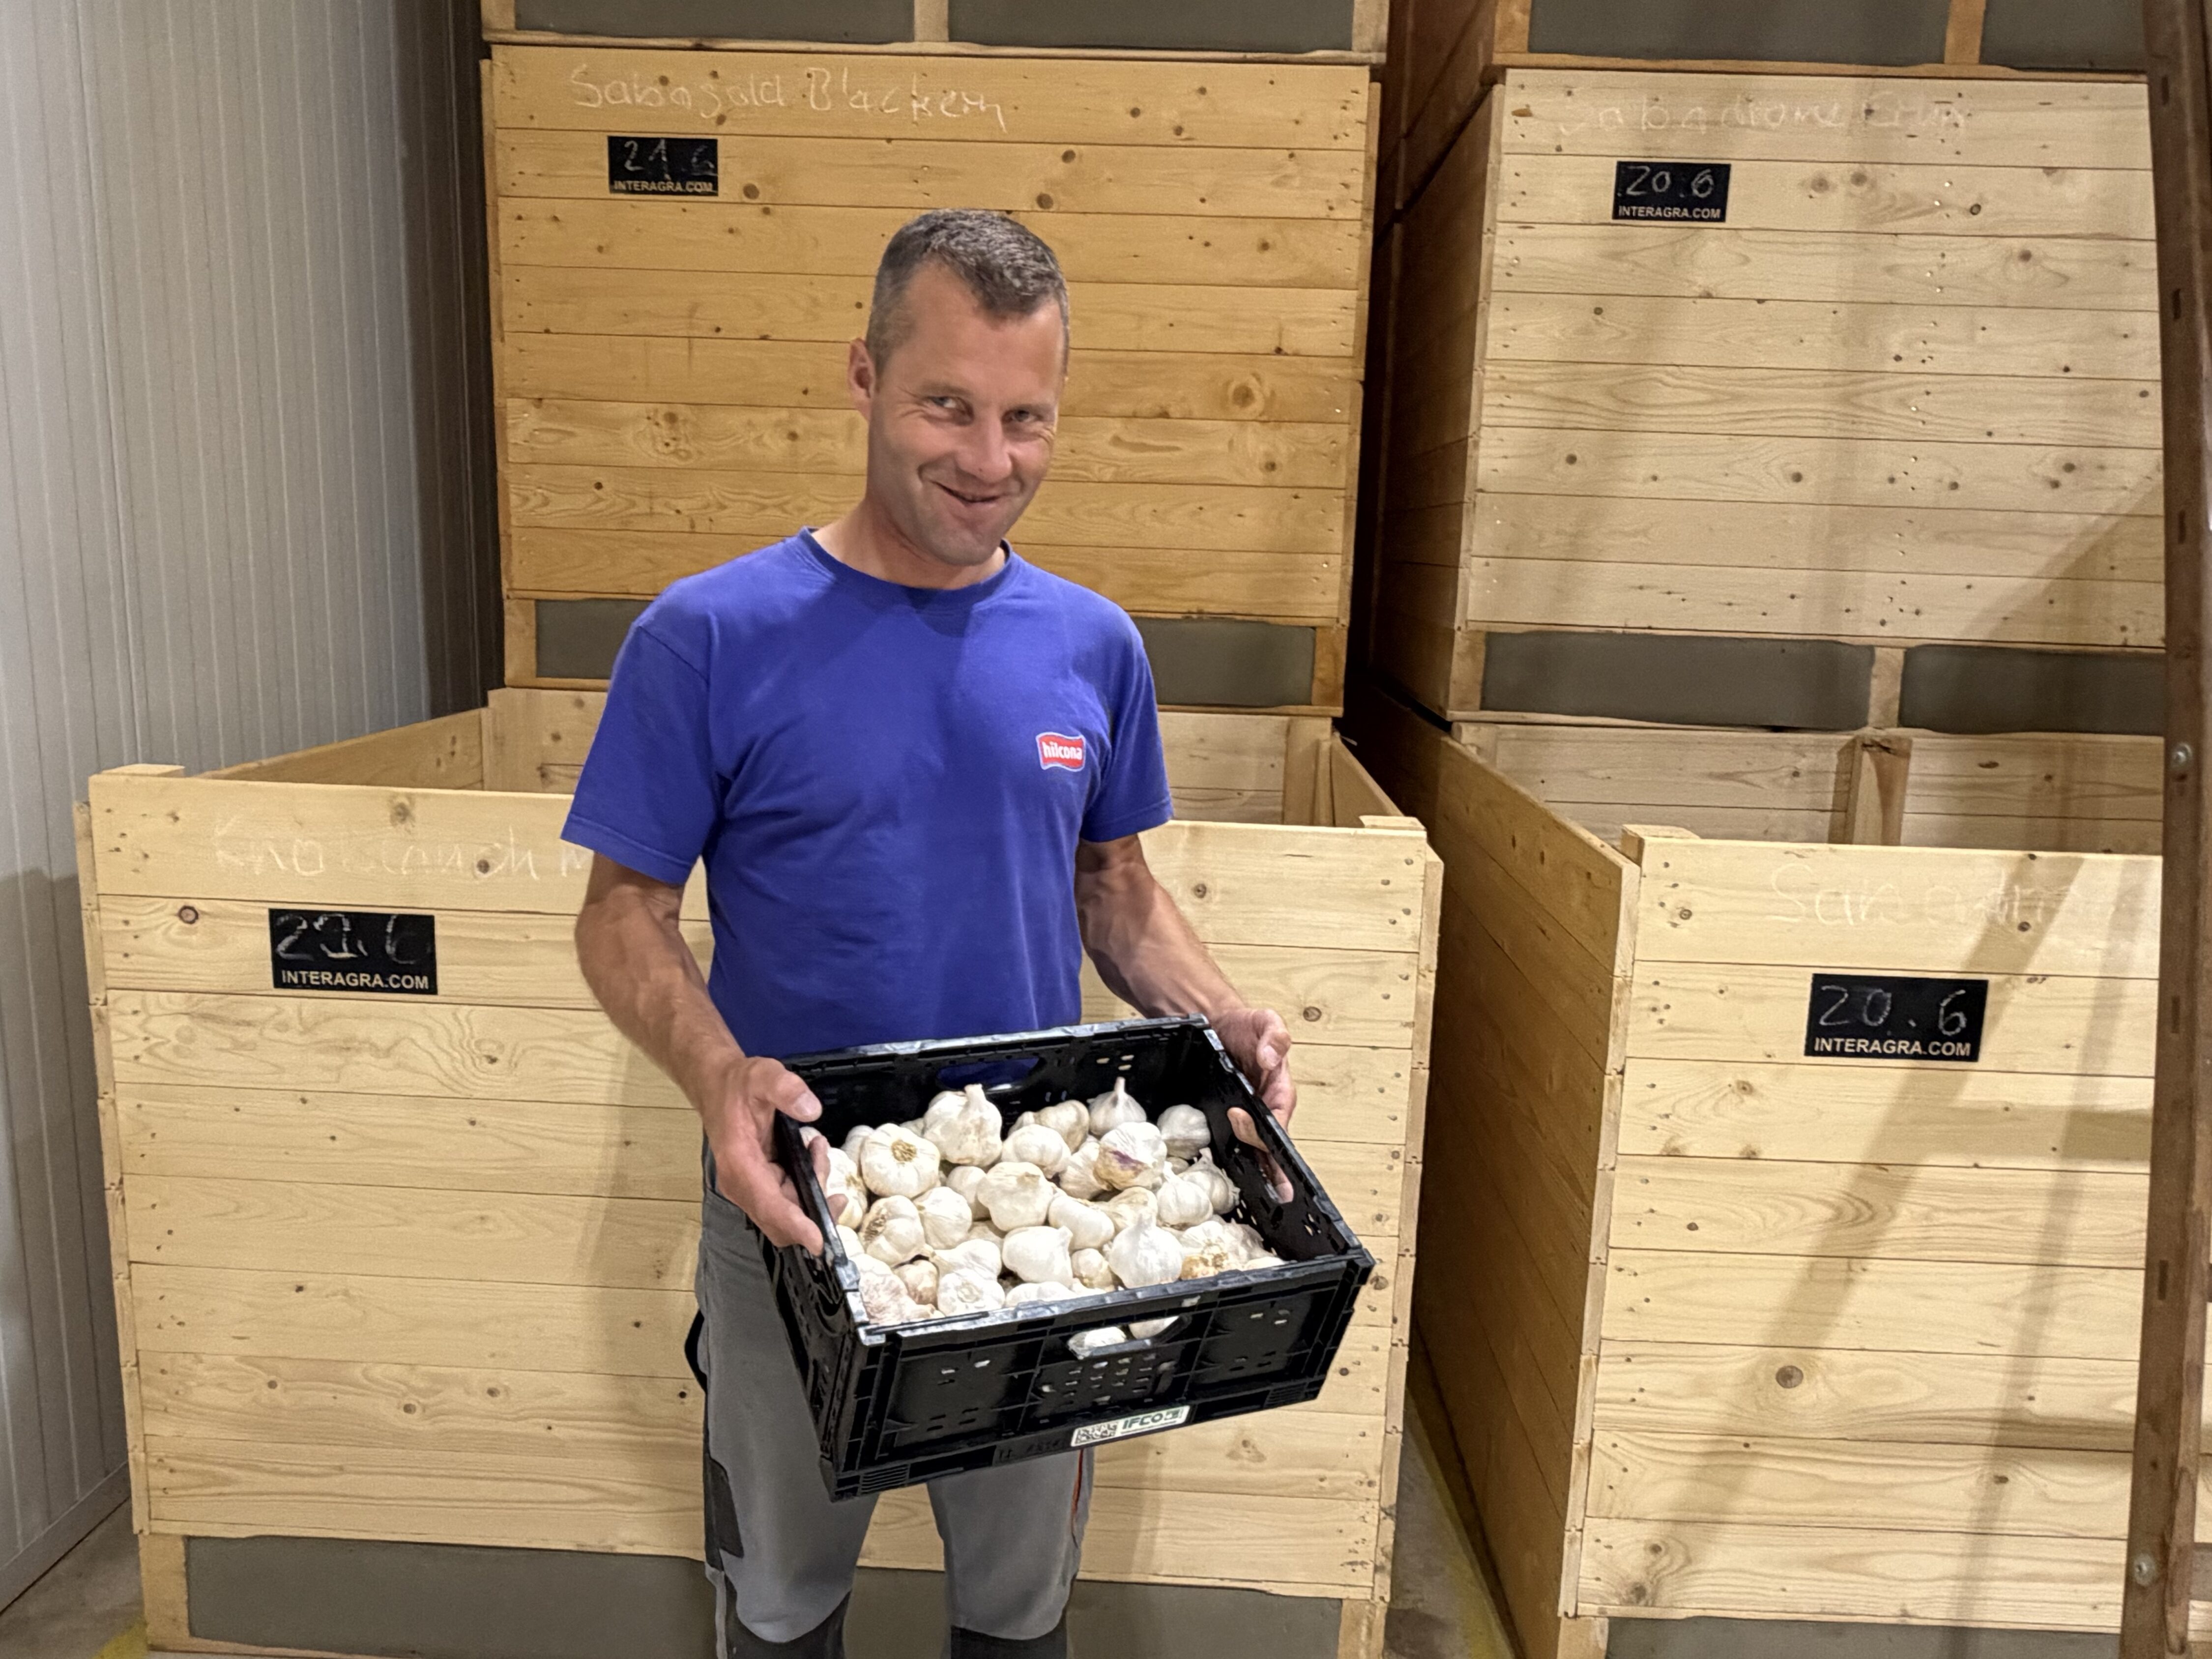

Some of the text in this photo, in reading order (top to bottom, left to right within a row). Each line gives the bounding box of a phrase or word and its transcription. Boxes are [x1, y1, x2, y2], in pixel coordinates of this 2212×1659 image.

[614, 180, 713, 192] INTERAGRA.COM
[1619, 205, 1721, 219] INTERAGRA.COM
[1042, 741, 1082, 760] hilcona
[282, 970, 429, 990] INTERAGRA.COM
[1814, 1037, 1971, 1056] INTERAGRA.COM
[1122, 1413, 1164, 1430] IFCO
